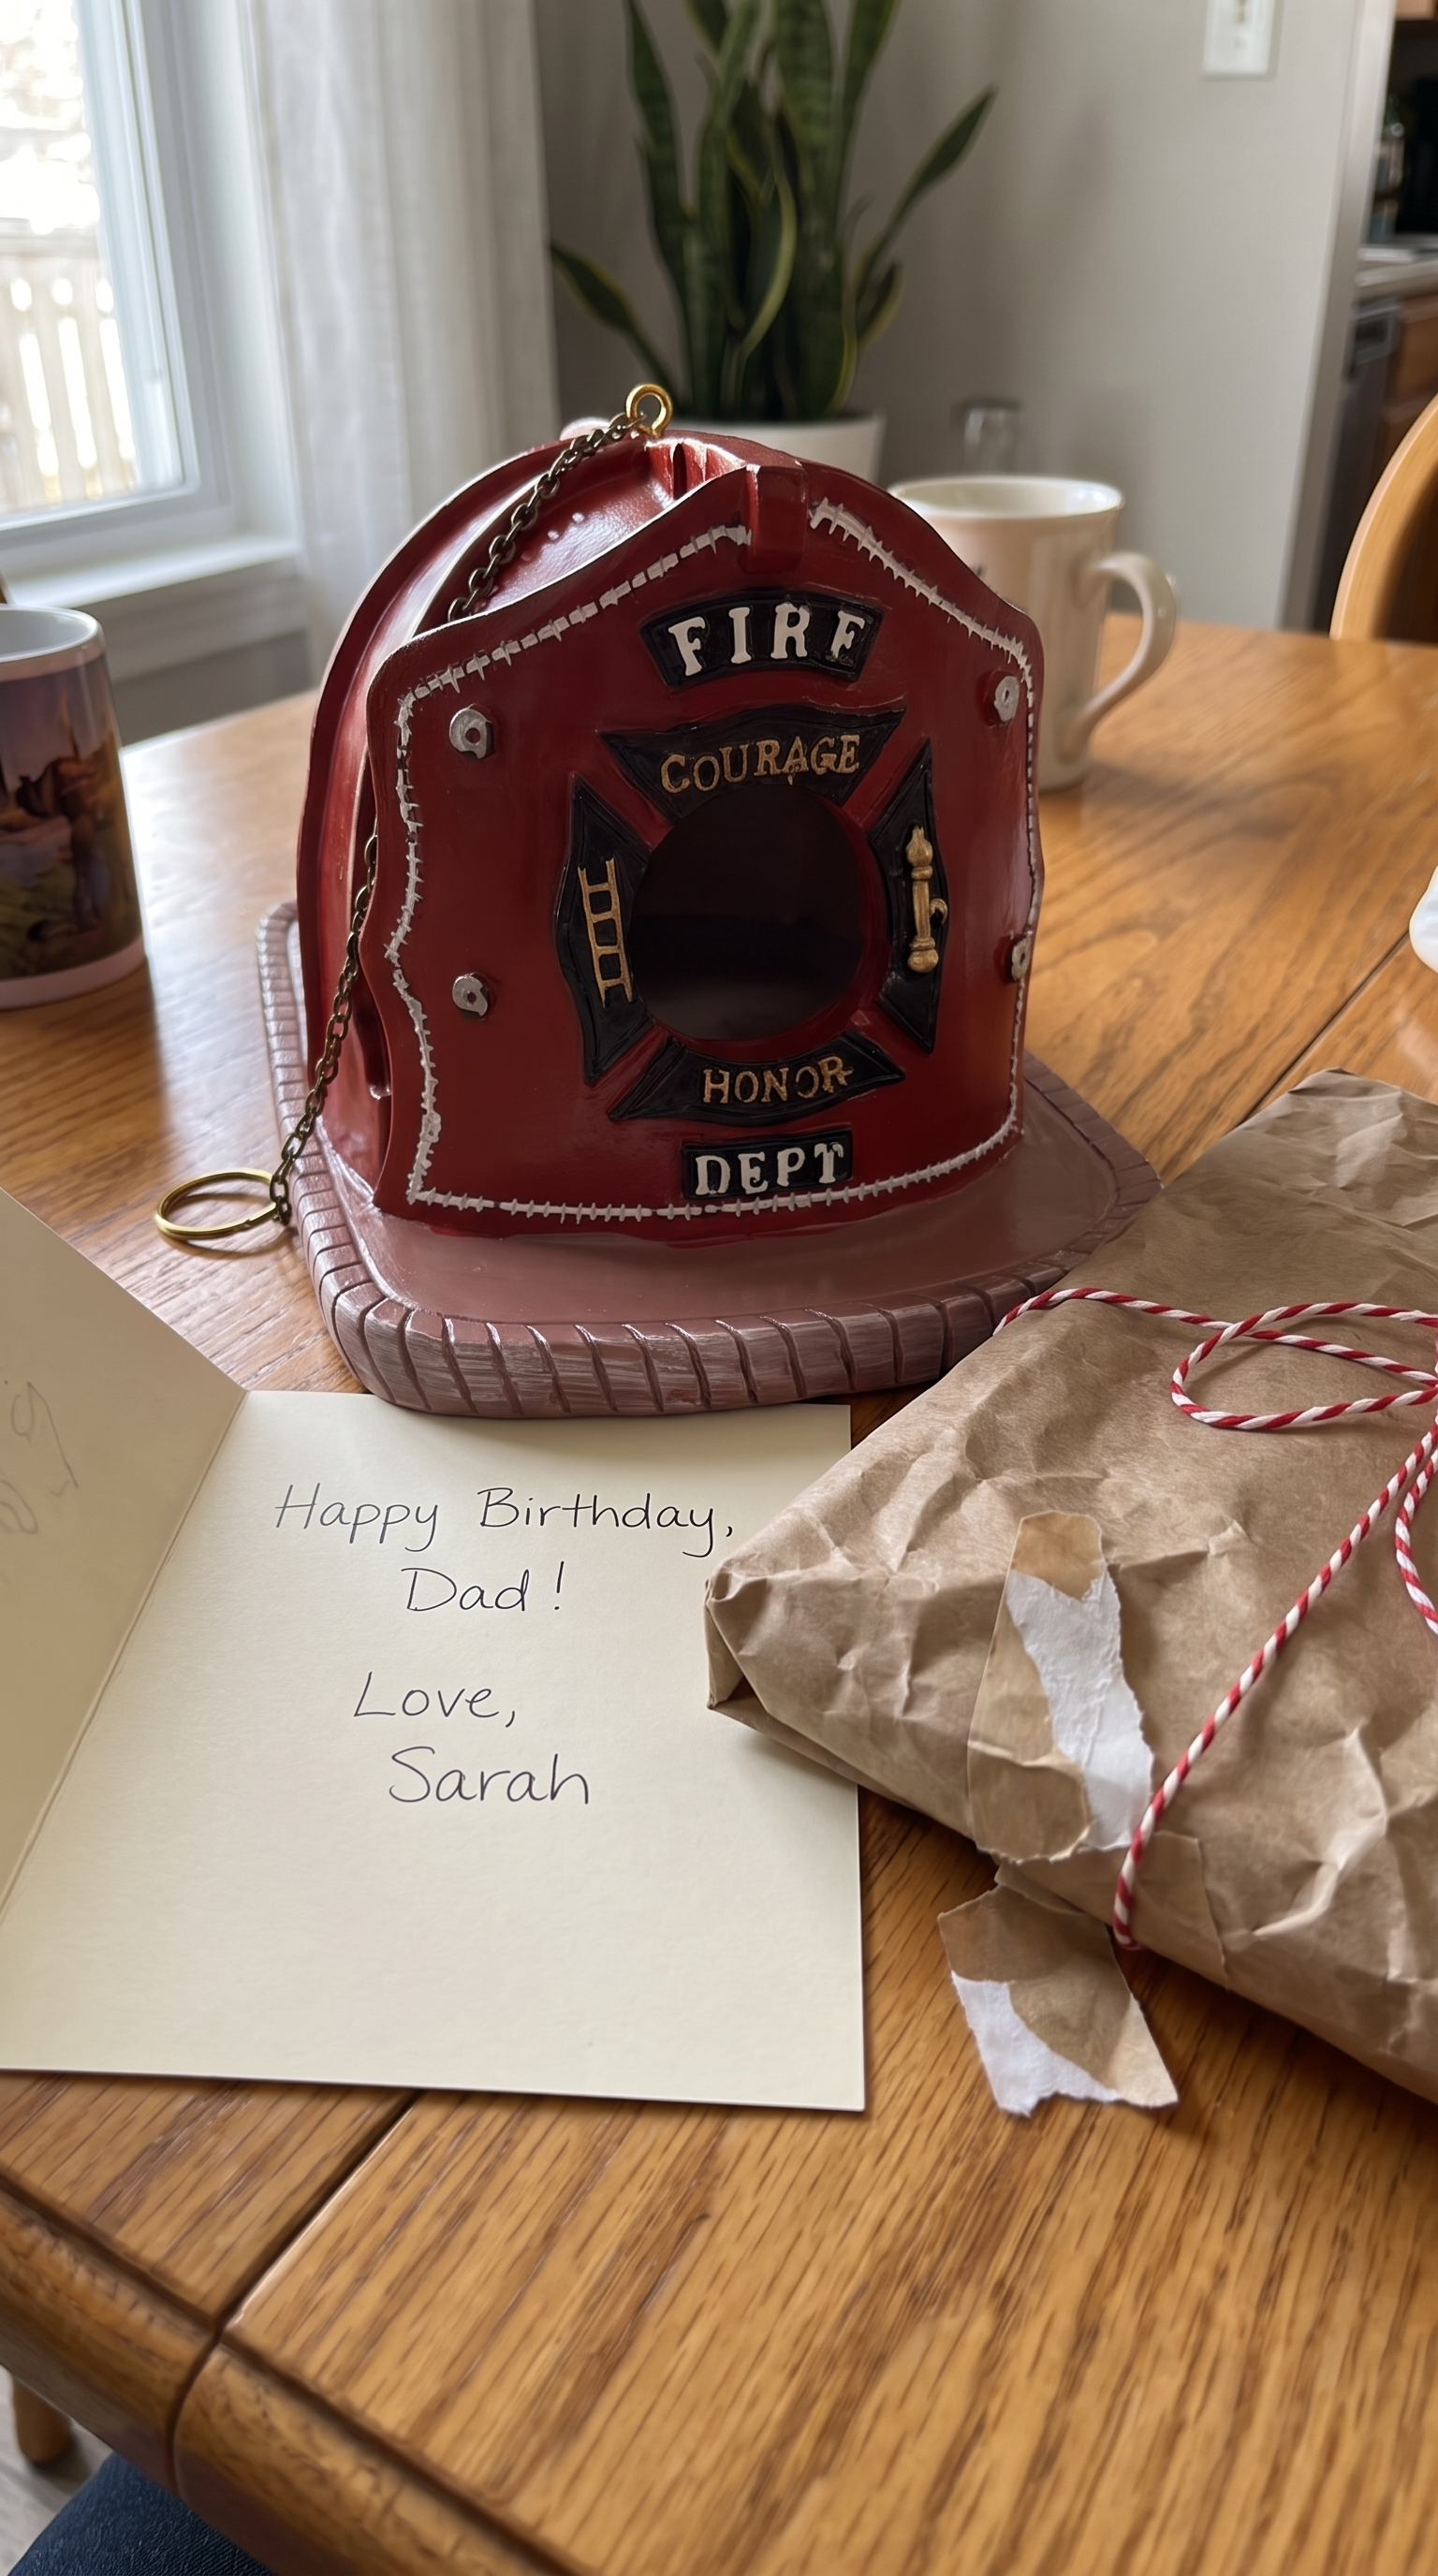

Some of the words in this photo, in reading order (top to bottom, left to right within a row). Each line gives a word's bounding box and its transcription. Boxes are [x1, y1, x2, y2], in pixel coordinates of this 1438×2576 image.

[660, 734, 860, 794] COURAGE
[702, 1055, 855, 1105] HONOR
[695, 1141, 844, 1196] DEPT
[274, 1482, 439, 1553] Happy
[477, 1486, 735, 1559] Birthday,
[353, 1671, 516, 1729] Love,
[389, 1745, 590, 1806] Sarah
